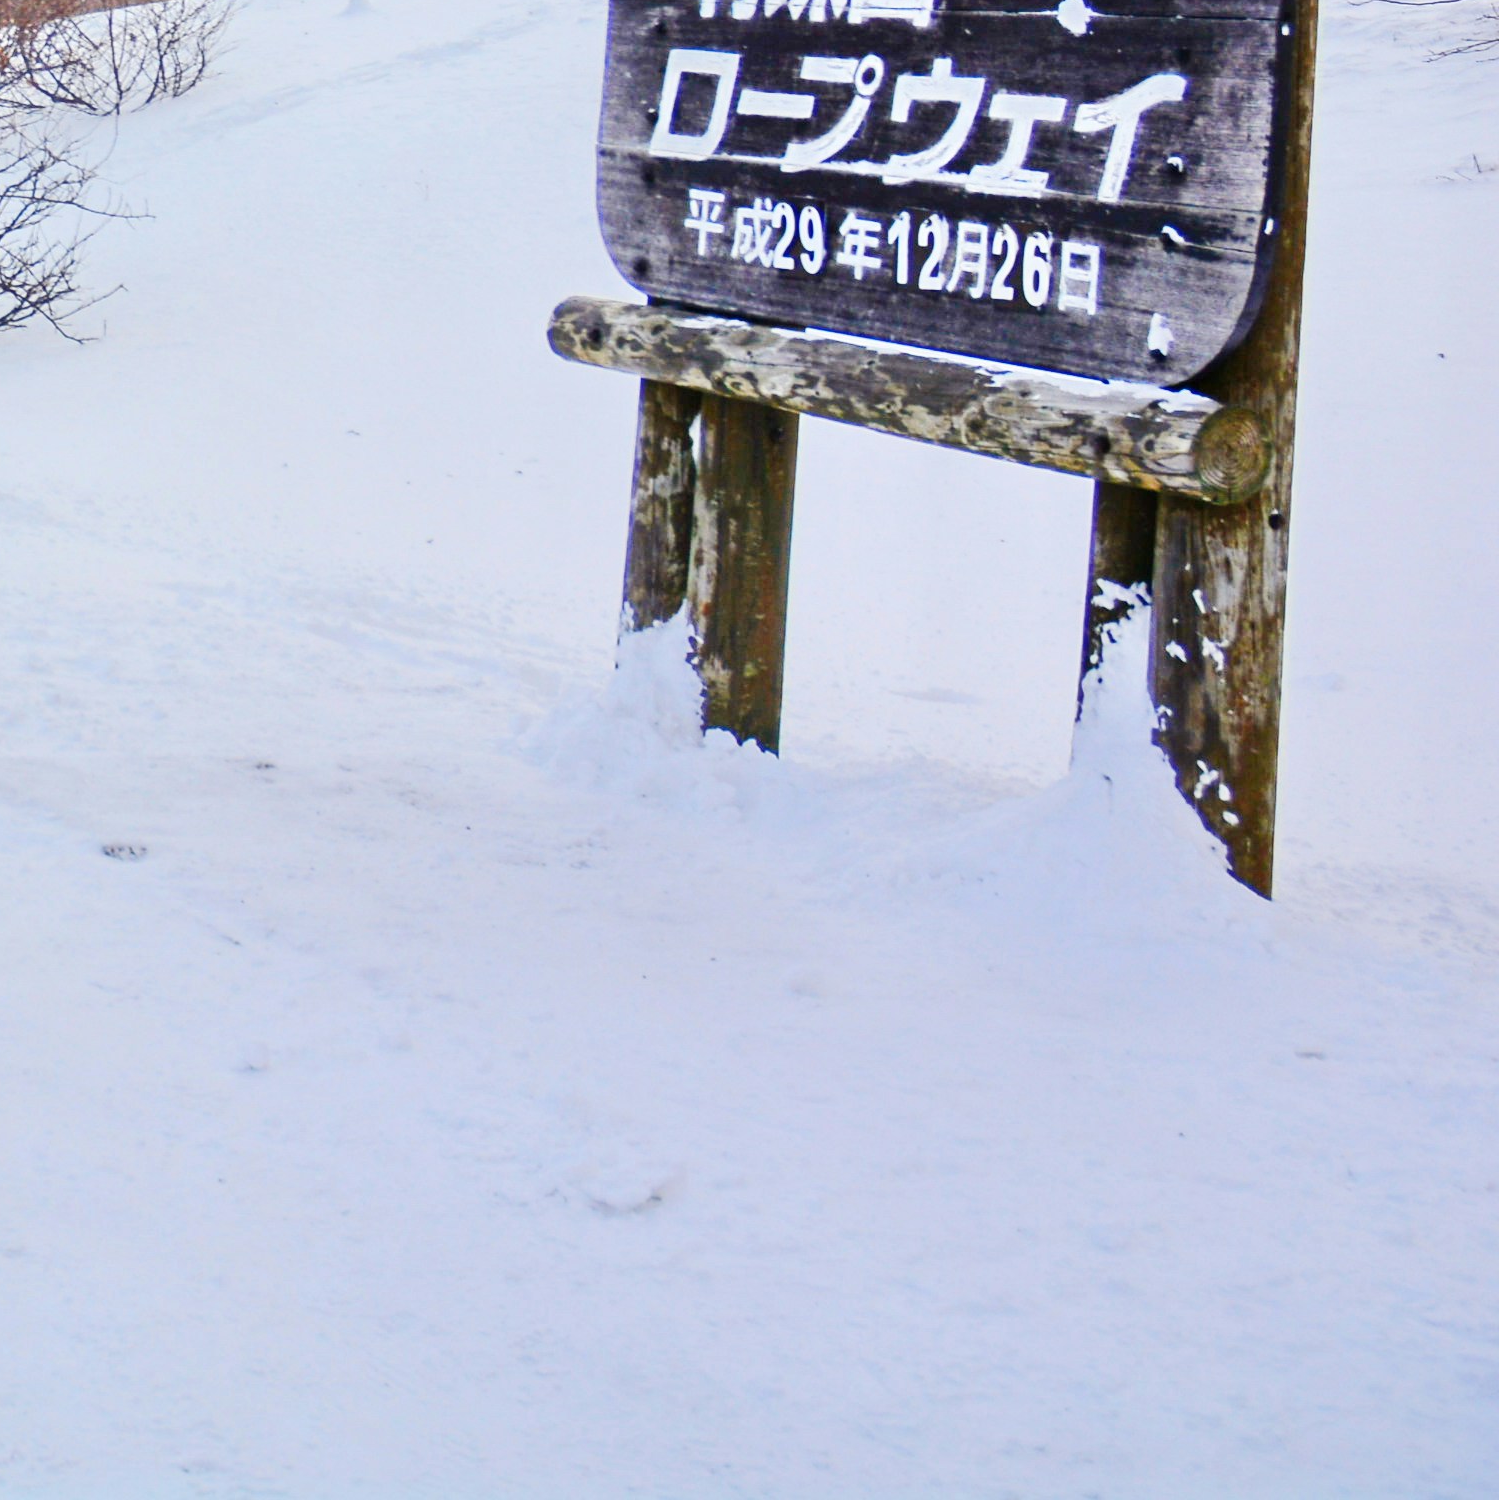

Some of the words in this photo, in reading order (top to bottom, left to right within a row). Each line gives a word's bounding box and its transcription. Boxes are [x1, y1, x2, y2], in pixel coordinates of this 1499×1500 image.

[650, 50, 1187, 202] ロープウェイ
